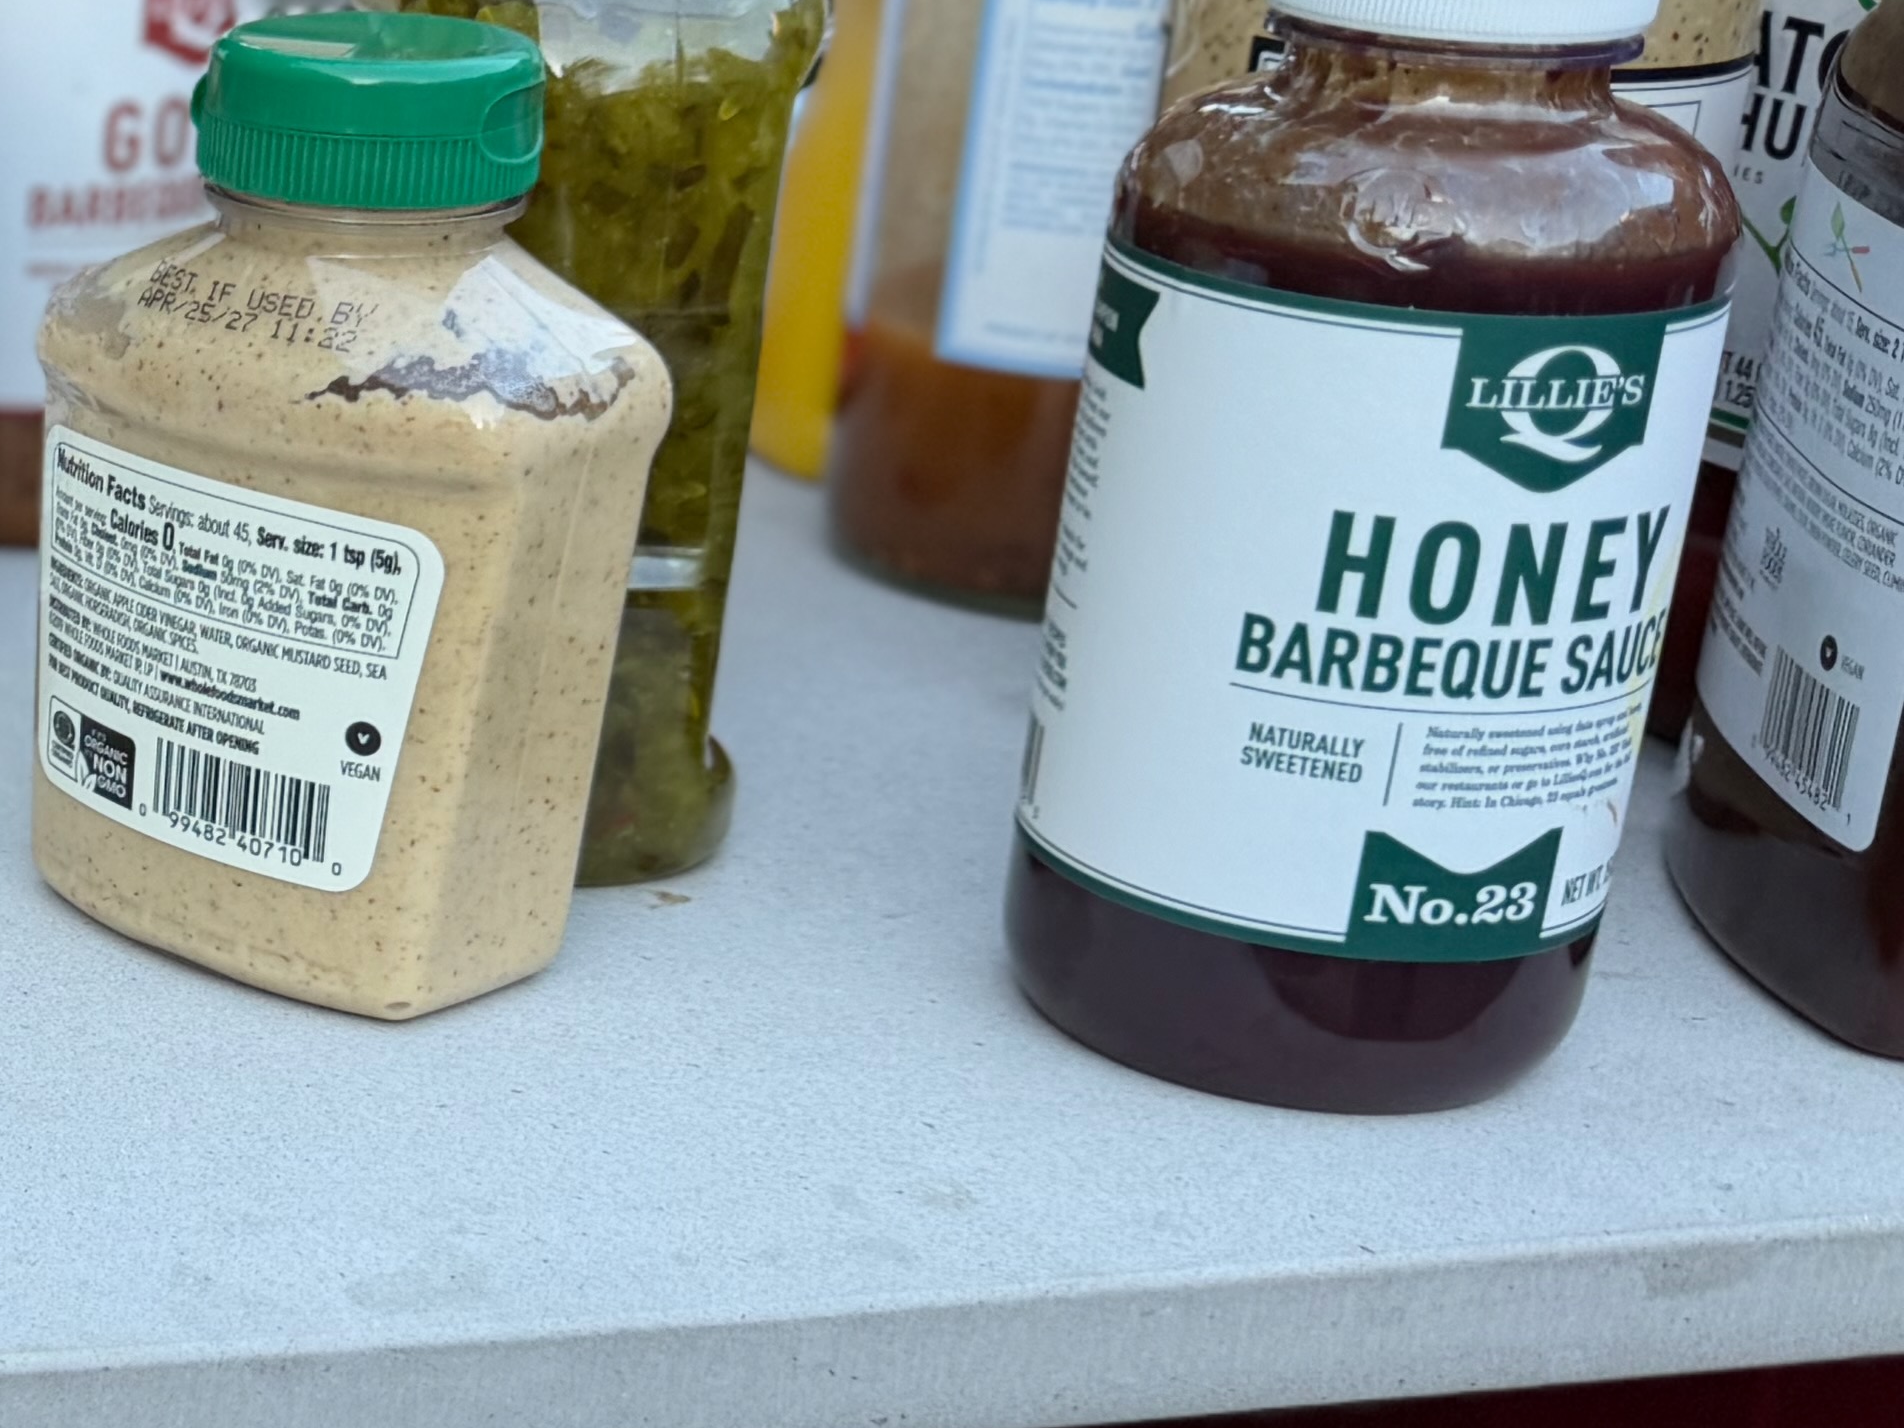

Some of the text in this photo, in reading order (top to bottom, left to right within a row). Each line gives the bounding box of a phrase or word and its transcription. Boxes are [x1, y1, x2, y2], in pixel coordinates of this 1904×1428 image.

[103, 97, 192, 173] GO
[150, 260, 199, 293] BEST
[208, 281, 236, 302] IF
[247, 288, 315, 319] USED
[138, 286, 258, 332] APR/25/27
[1465, 374, 1645, 409] LILLIE'S
[1499, 345, 1621, 463] Q
[57, 447, 104, 493] Nutrition
[106, 474, 146, 511] Facts
[198, 512, 230, 539] about
[234, 520, 252, 547] 45,
[257, 526, 289, 552] Serv.
[293, 534, 325, 559] size:
[330, 541, 337, 561] 1
[344, 544, 365, 570] tsp
[110, 508, 159, 546] Calories
[204, 550, 220, 566] Fat
[222, 552, 234, 571] 0g
[310, 574, 326, 590] Fat
[329, 578, 343, 596] 0g
[1315, 504, 1671, 627] HONEY
[307, 590, 393, 621] Total 0g
[235, 634, 280, 660] ORGANIC
[281, 646, 331, 670] MUSTARD
[333, 657, 363, 678] SEED,
[366, 662, 387, 681] SEA
[1235, 611, 1553, 701] BARBEQUE
[1560, 608, 1668, 696] SAUCE
[193, 700, 265, 735] INTERNATIONAL
[1426, 726, 1545, 742] Naturally sweetened
[83, 734, 128, 766] ORGANIC
[187, 721, 214, 743] AFTER
[216, 730, 260, 755] OPENING
[1249, 722, 1365, 758] NATURALLY
[1422, 744, 1446, 756] free
[1451, 744, 1465, 756] of
[93, 754, 127, 784] NON
[340, 760, 381, 782] VEGAN
[1240, 746, 1363, 783] SWEETENED
[96, 774, 126, 798] GMO
[139, 803, 146, 816] 0
[168, 811, 226, 846] 99482
[236, 834, 303, 867] 40710
[1363, 881, 1537, 926] No.23
[1560, 873, 1586, 907] NET
